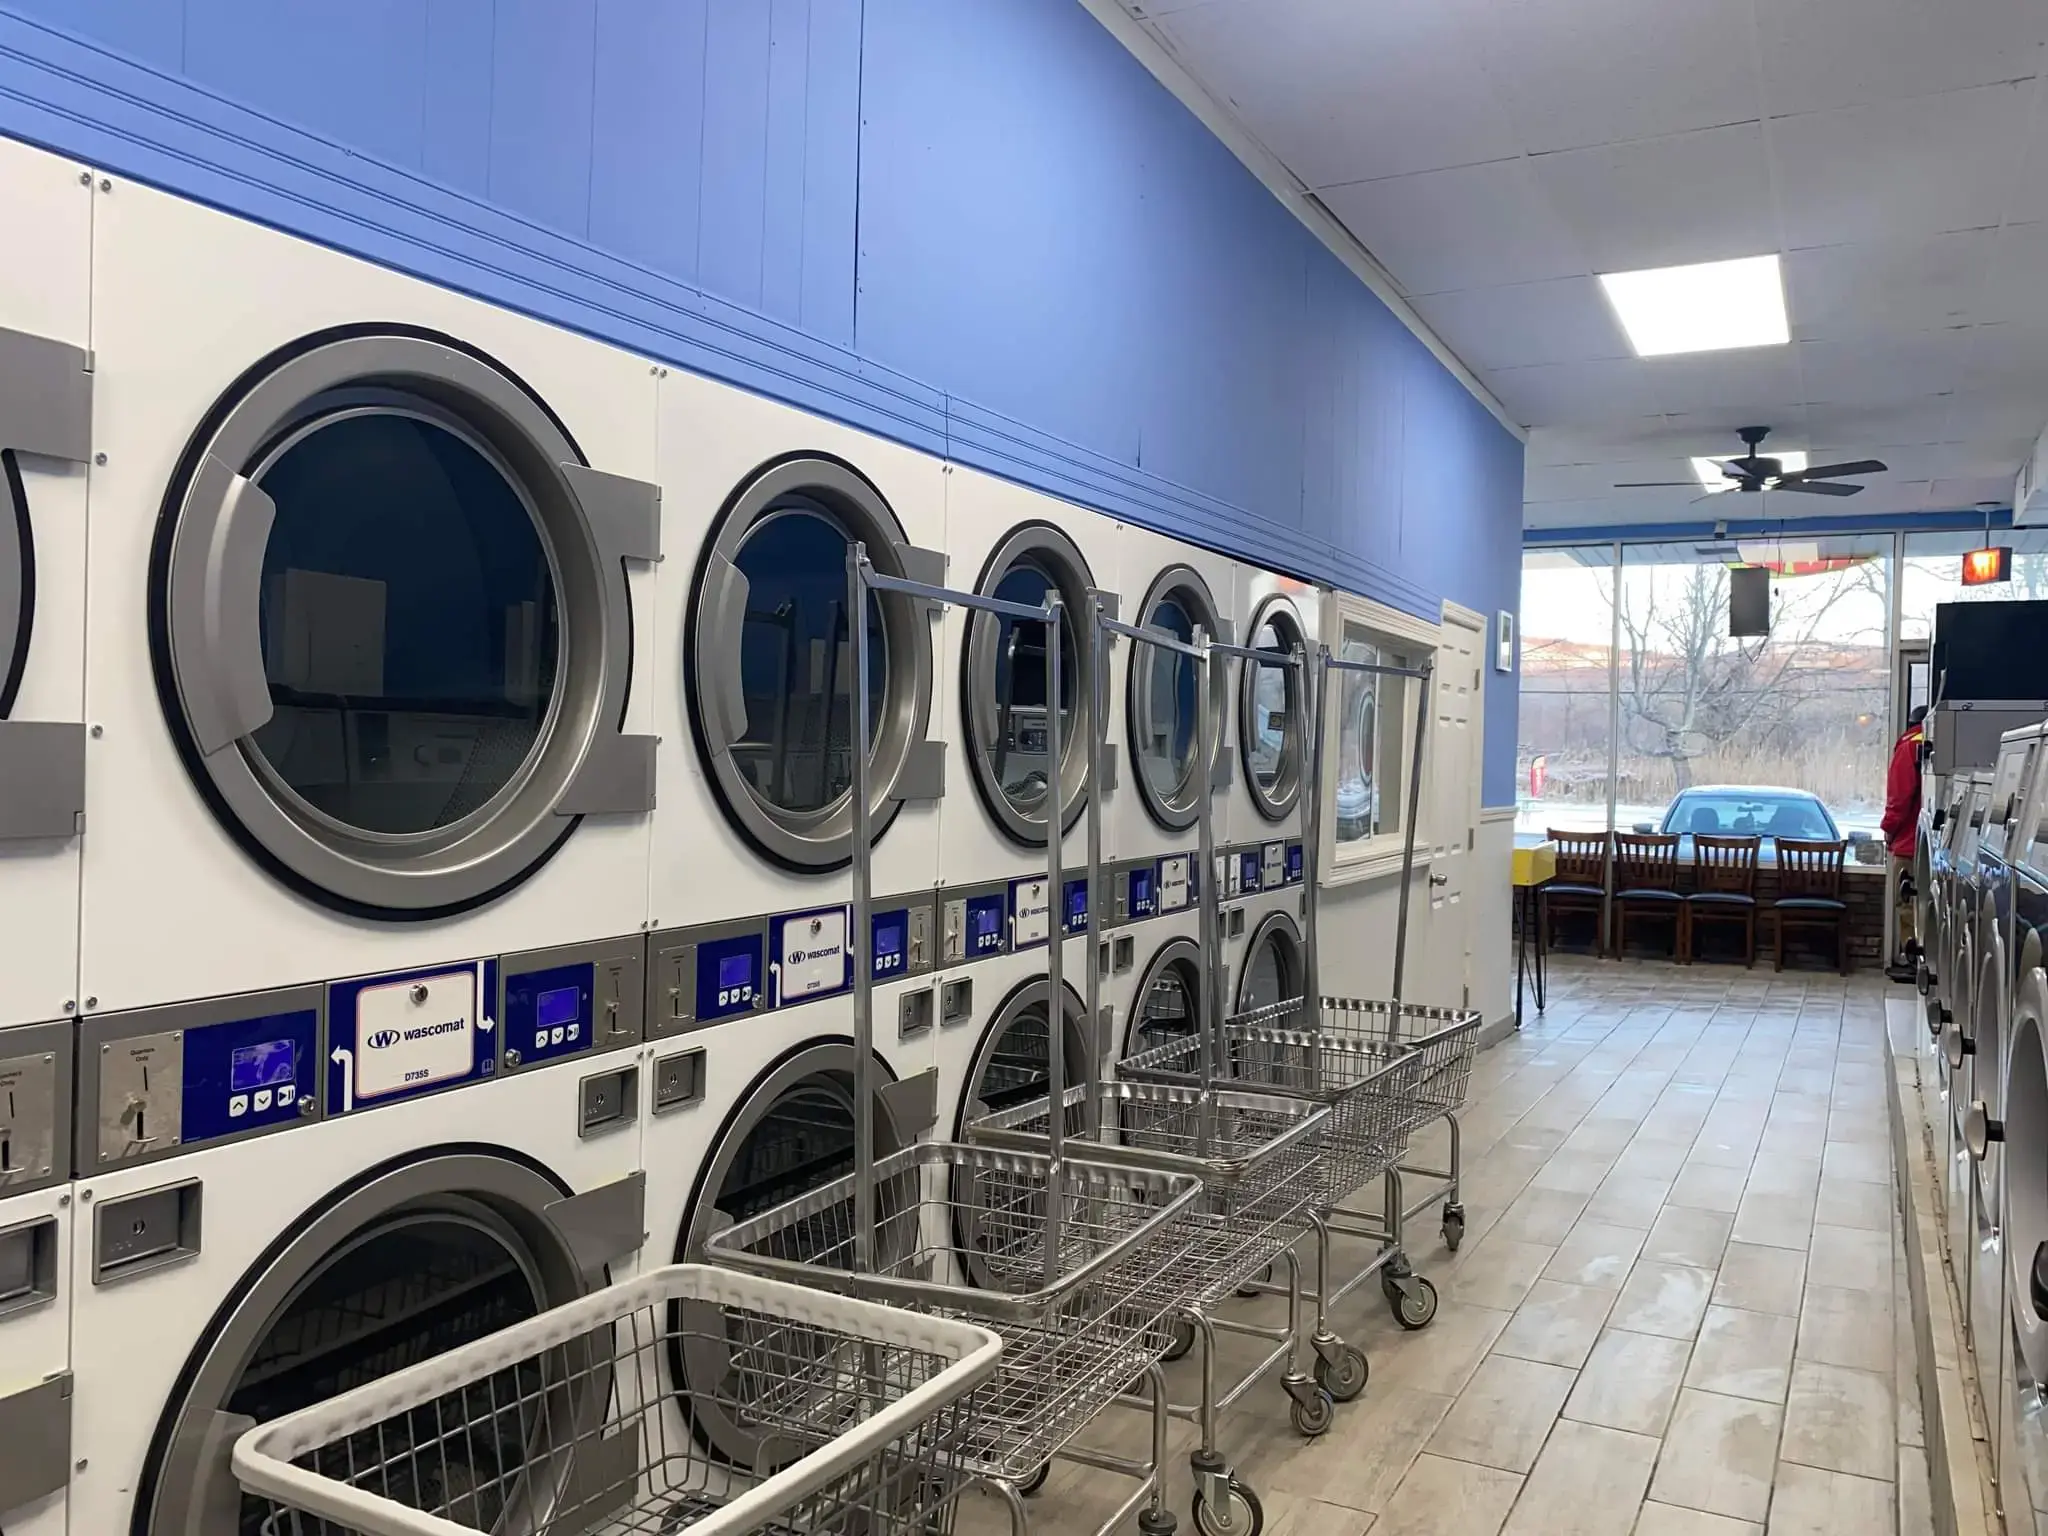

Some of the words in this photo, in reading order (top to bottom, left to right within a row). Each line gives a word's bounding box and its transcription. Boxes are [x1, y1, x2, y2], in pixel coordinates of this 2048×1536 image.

[807, 945, 840, 960] wascomat
[404, 1018, 464, 1040] wascomat
[404, 1069, 429, 1081] D735S
